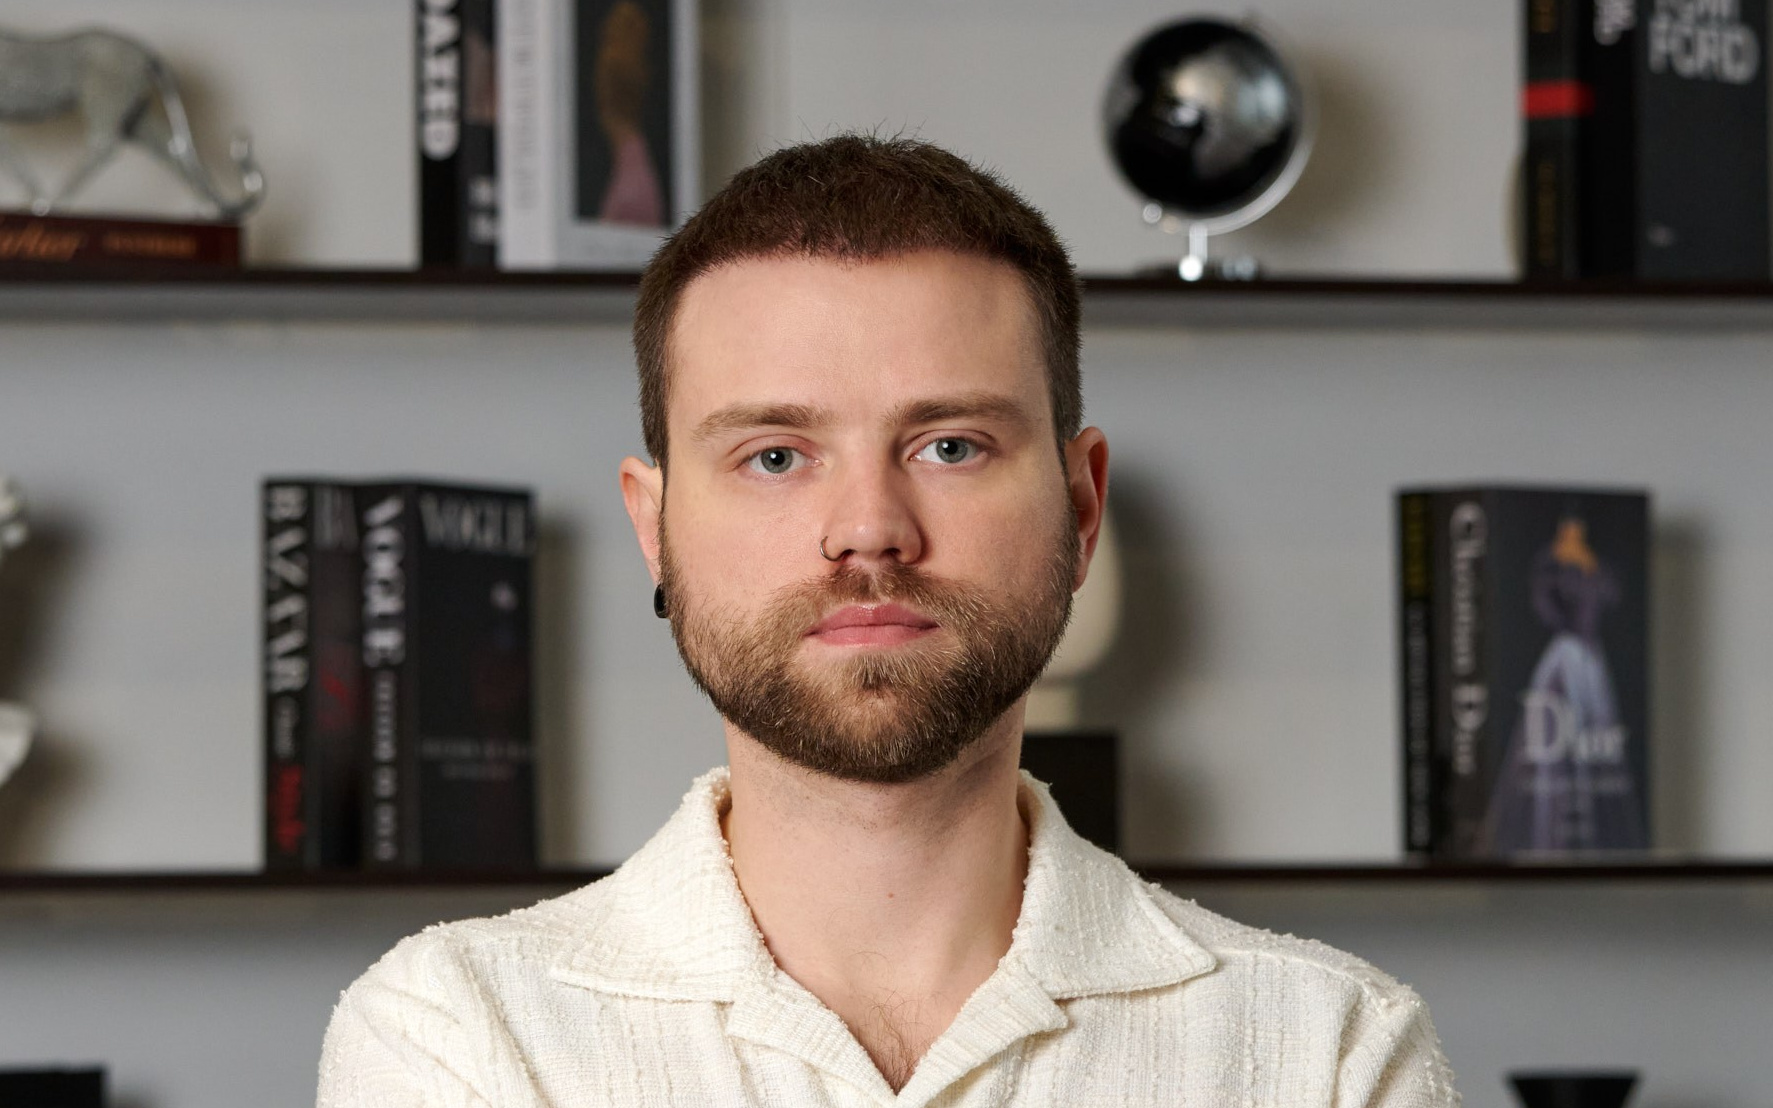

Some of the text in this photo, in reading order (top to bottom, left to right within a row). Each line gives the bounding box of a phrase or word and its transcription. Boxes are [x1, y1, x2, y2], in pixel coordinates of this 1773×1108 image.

[420, 0, 461, 161] AZED
[1648, 14, 1761, 85] FORD
[362, 494, 405, 668] VOGUE
